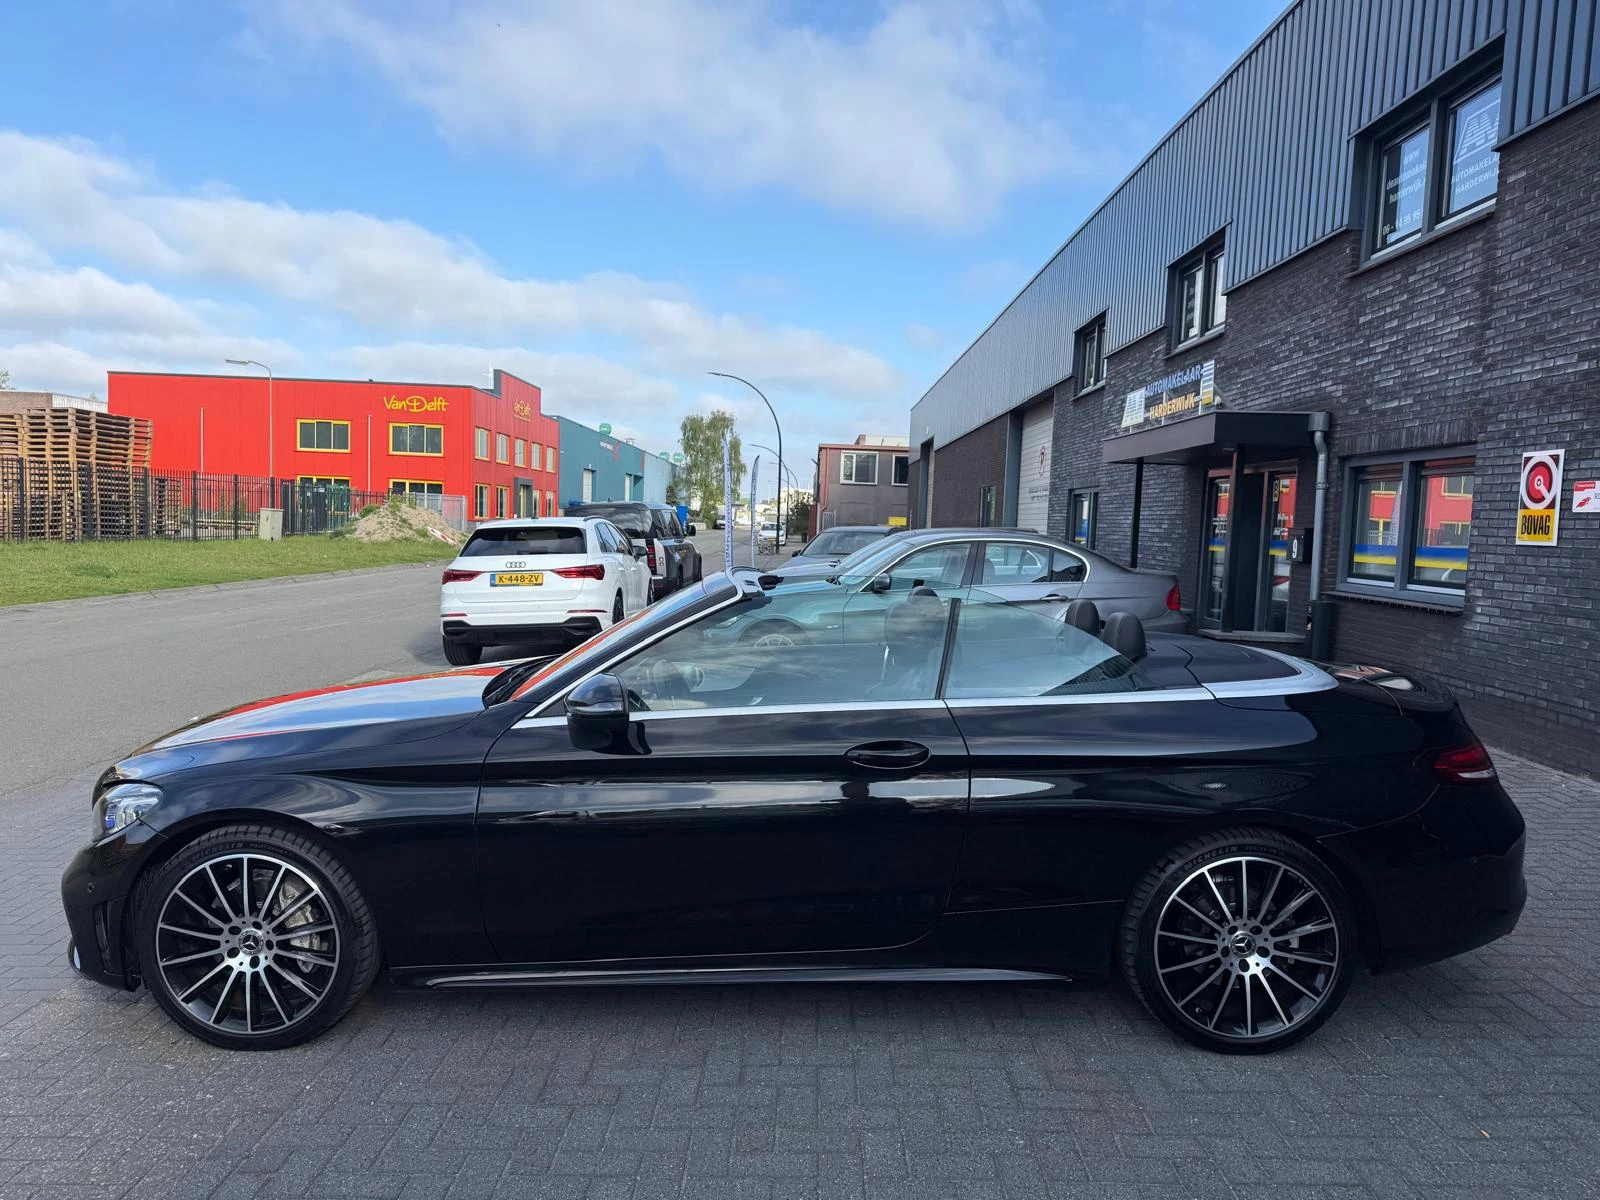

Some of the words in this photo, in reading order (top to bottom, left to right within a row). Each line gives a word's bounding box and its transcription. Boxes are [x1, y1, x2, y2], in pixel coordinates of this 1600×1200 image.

[1455, 168, 1498, 195] HARDERWIJ
[1145, 364, 1201, 398] AUTOMAKELAAR
[1150, 392, 1196, 420] HARDERWIJK
[1521, 514, 1551, 536] BOVAG
[1292, 539, 1298, 559] 9
[498, 574, 540, 584] K-448-ZV
[1184, 845, 1238, 871] MICHELIN
